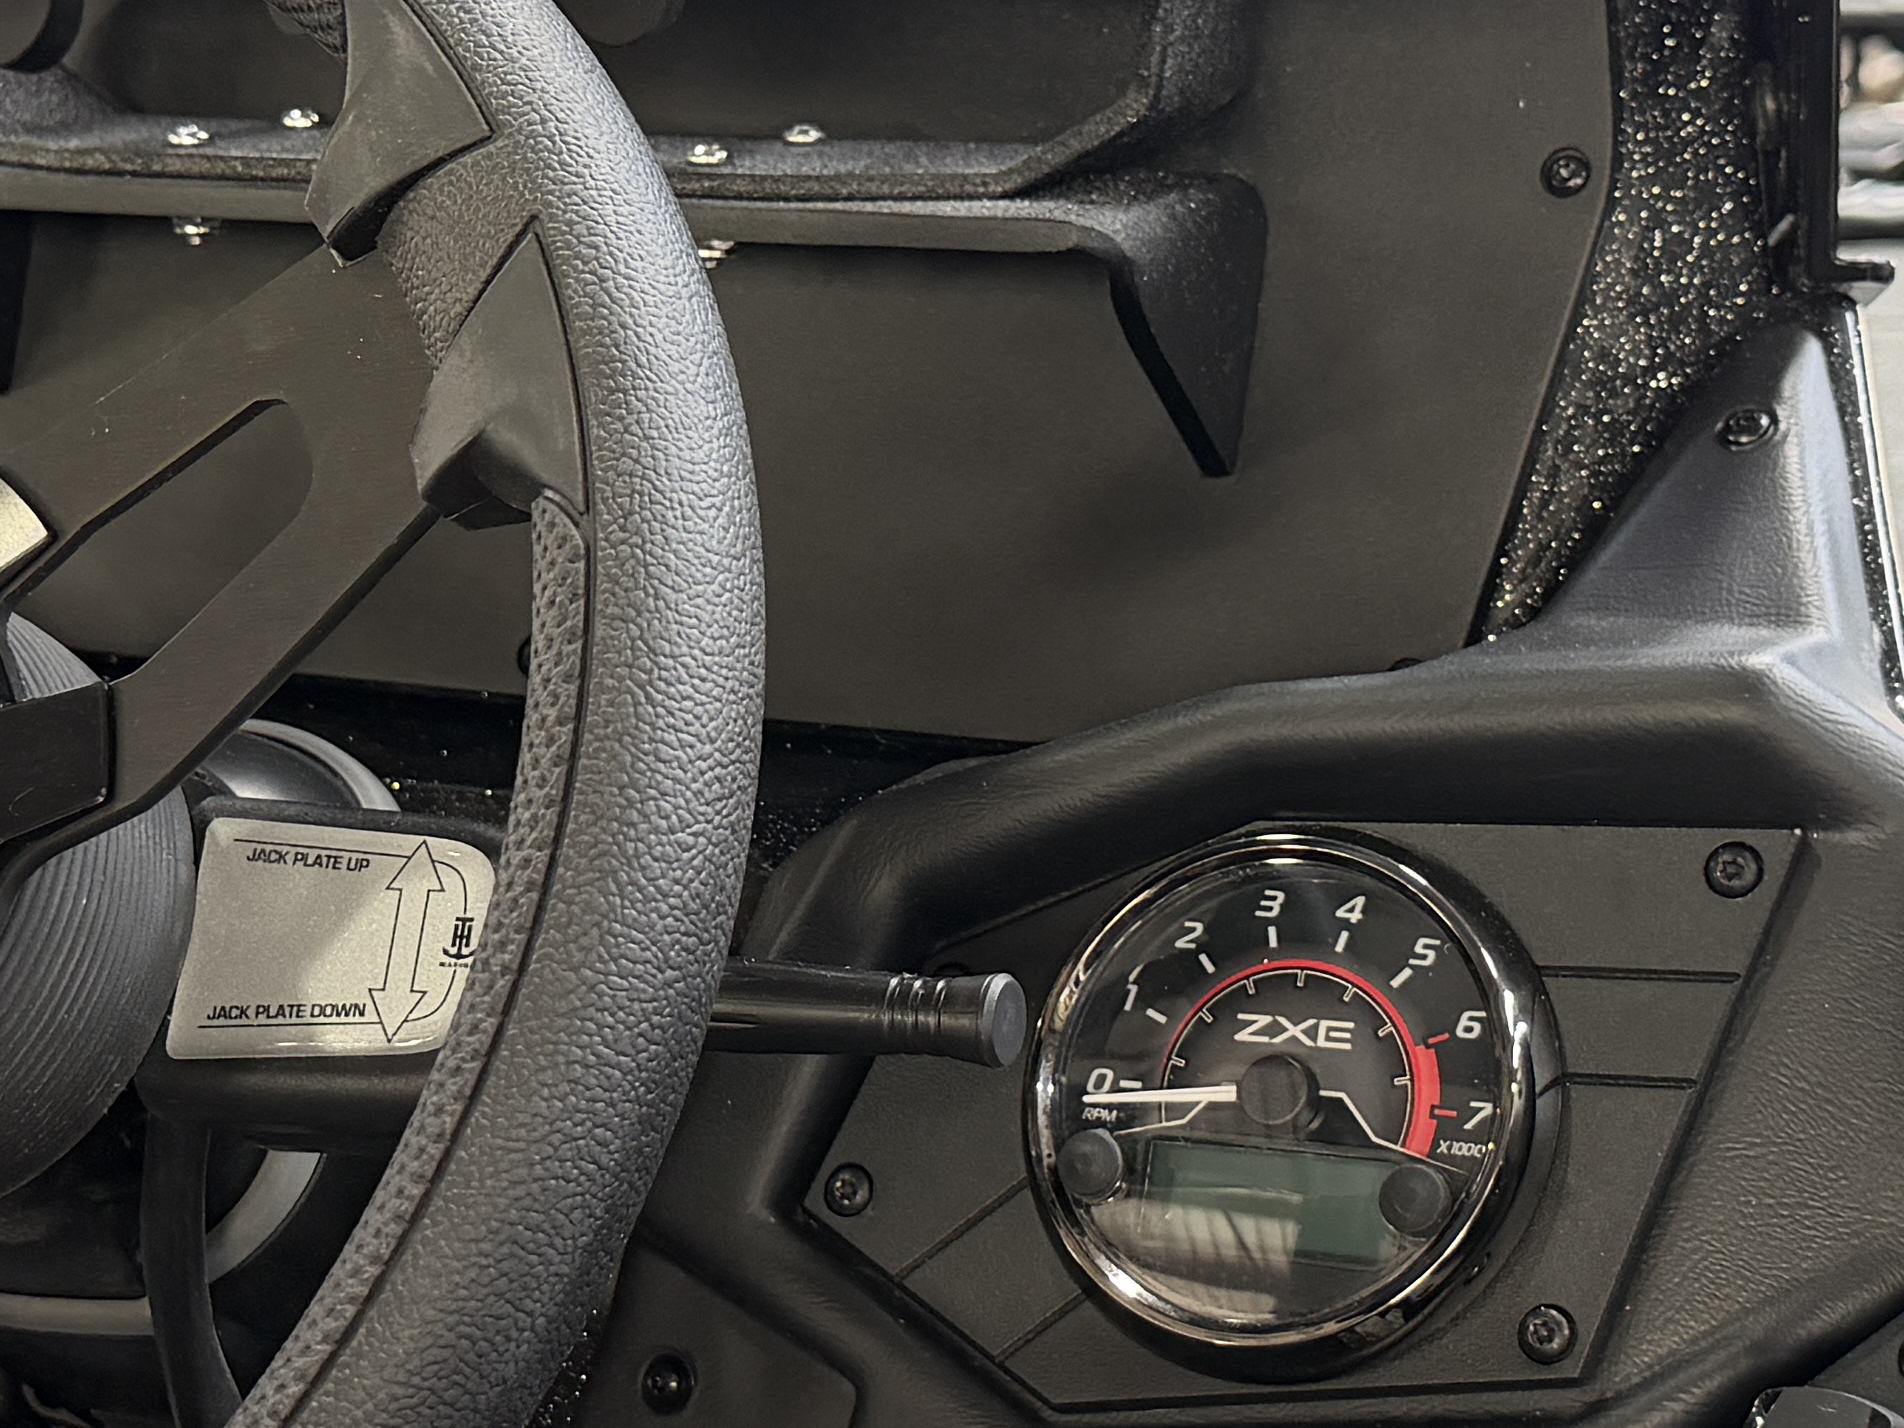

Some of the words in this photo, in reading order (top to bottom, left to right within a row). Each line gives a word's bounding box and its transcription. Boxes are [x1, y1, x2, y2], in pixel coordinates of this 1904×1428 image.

[246, 847, 290, 865] JACK
[292, 851, 344, 871] PLATE
[346, 856, 370, 873] UP
[1254, 889, 1286, 918] 3
[1335, 895, 1367, 924] 4
[1174, 921, 1204, 949] 2
[1408, 937, 1442, 967] 5
[207, 1004, 251, 1020] JACK
[254, 1003, 307, 1019] PLATE
[309, 1002, 367, 1018] DOWN
[1123, 983, 1139, 1011] 1
[1233, 1012, 1356, 1050] ZXE
[1455, 1010, 1488, 1040] 6
[1086, 1067, 1115, 1094] 0
[1082, 1106, 1118, 1122] RPM
[1463, 1100, 1494, 1130] 7
